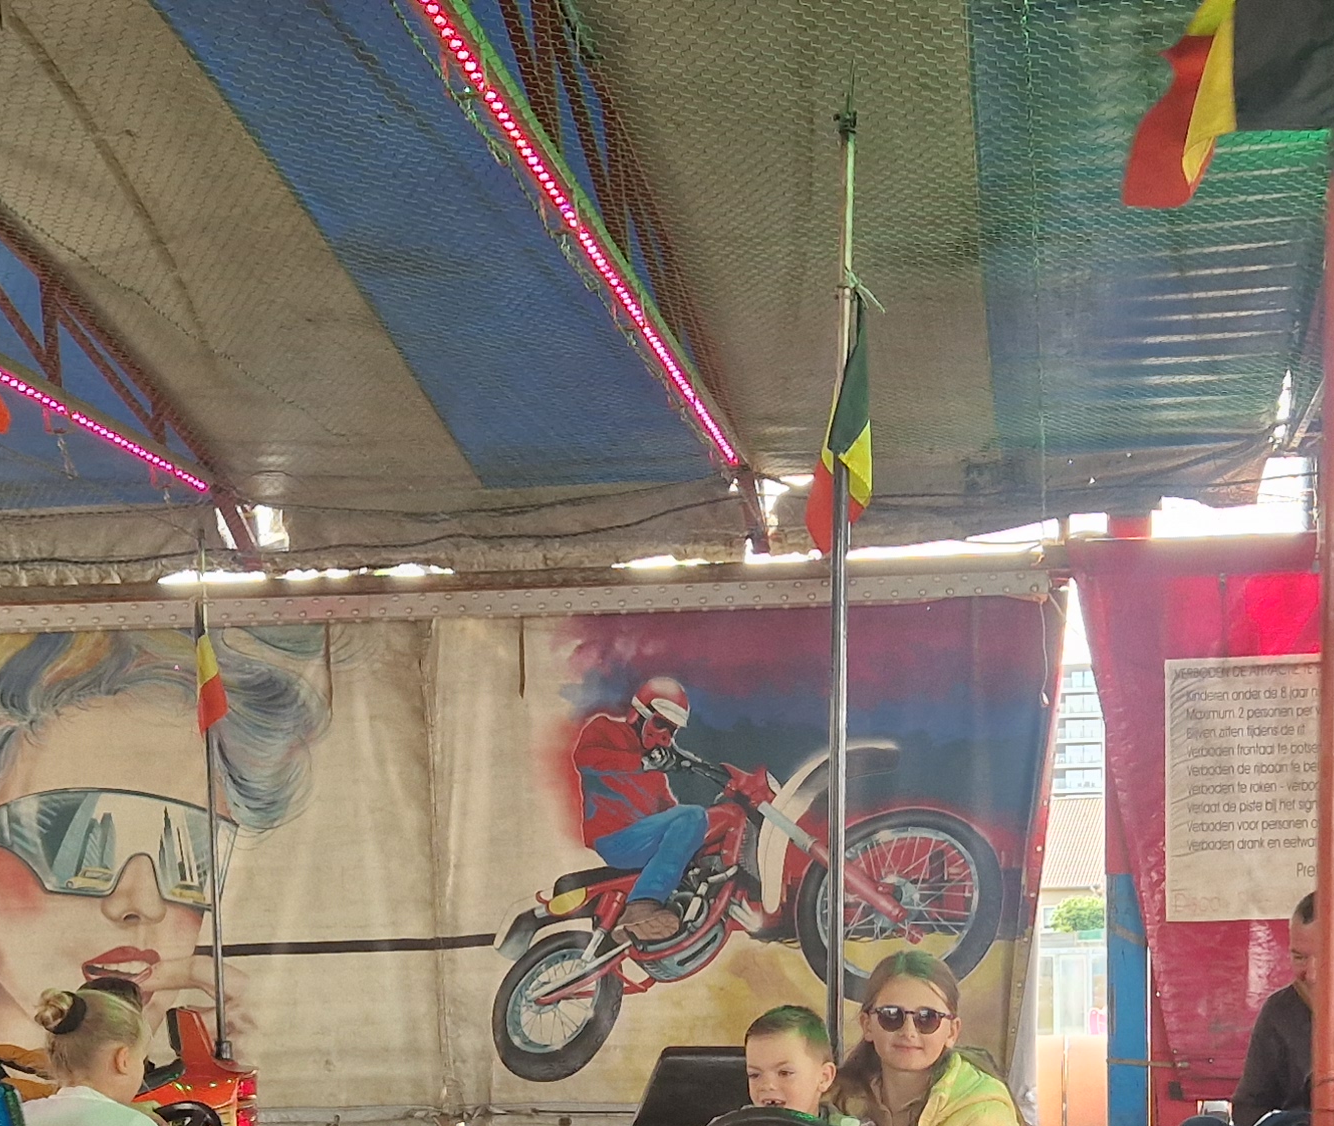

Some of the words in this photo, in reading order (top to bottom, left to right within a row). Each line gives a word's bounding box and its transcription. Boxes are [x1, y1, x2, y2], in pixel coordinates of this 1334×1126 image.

[1174, 667, 1229, 680] VERBODEN
[1233, 666, 1247, 678] DE
[1186, 688, 1229, 701] Kinderen
[1231, 687, 1262, 700] onder
[1264, 687, 1278, 699] de
[1280, 687, 1287, 698] 8
[1289, 686, 1309, 700] jaar
[1186, 707, 1235, 720] Maximum
[1238, 707, 1244, 719] 2
[1247, 707, 1294, 720] personen
[1296, 707, 1313, 720] per
[1218, 725, 1244, 738] zitten
[1246, 724, 1278, 738] tijdens
[1280, 724, 1294, 736] de
[1297, 724, 1305, 736] rit
[1187, 745, 1234, 758] Verboden
[1237, 743, 1275, 756] frontaal
[1278, 743, 1287, 754] te
[1290, 742, 1322, 754] botse
[1187, 764, 1234, 777] Verboden
[1237, 763, 1251, 775] de
[1253, 762, 1287, 776] rijbaan
[1290, 761, 1300, 773] te
[1187, 782, 1234, 795] Verboden
[1237, 782, 1247, 793] te
[1249, 781, 1276, 793] roken
[1187, 801, 1220, 814] Verlaat
[1223, 801, 1237, 813] de
[1239, 800, 1263, 814] piste
[1265, 800, 1277, 813] bij
[1280, 799, 1296, 811] het
[1187, 820, 1234, 833] Verboden
[1237, 820, 1259, 831] voor
[1261, 818, 1308, 832] personen
[1187, 838, 1234, 851] Verboden
[1237, 837, 1264, 850] drank
[1267, 838, 1280, 849] en
